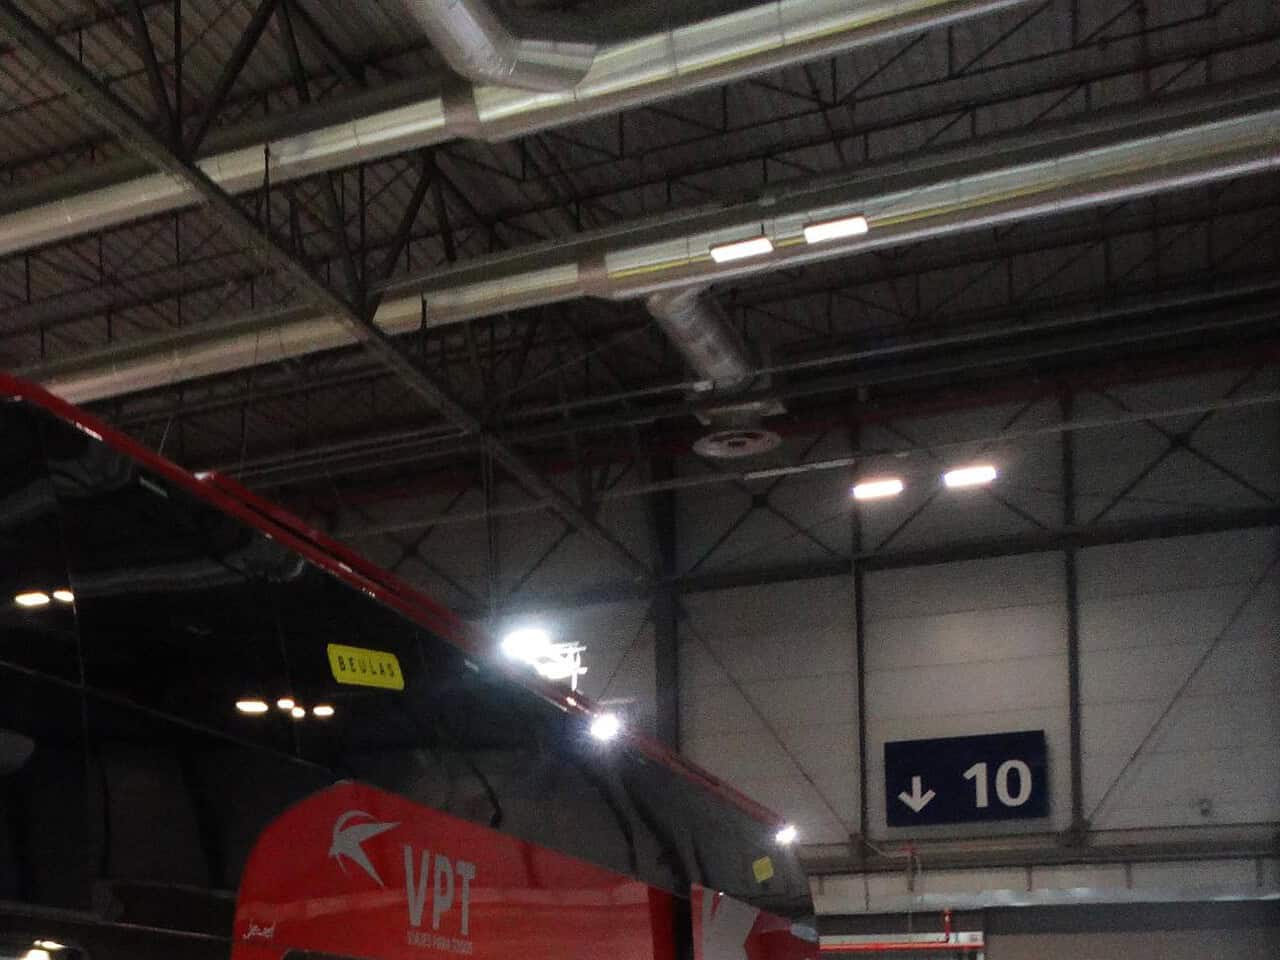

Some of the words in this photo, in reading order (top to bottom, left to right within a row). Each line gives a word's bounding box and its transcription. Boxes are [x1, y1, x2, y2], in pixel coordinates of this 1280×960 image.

[337, 655, 396, 679] BEULAS
[963, 759, 1032, 808] 10
[404, 844, 477, 936] VPT
